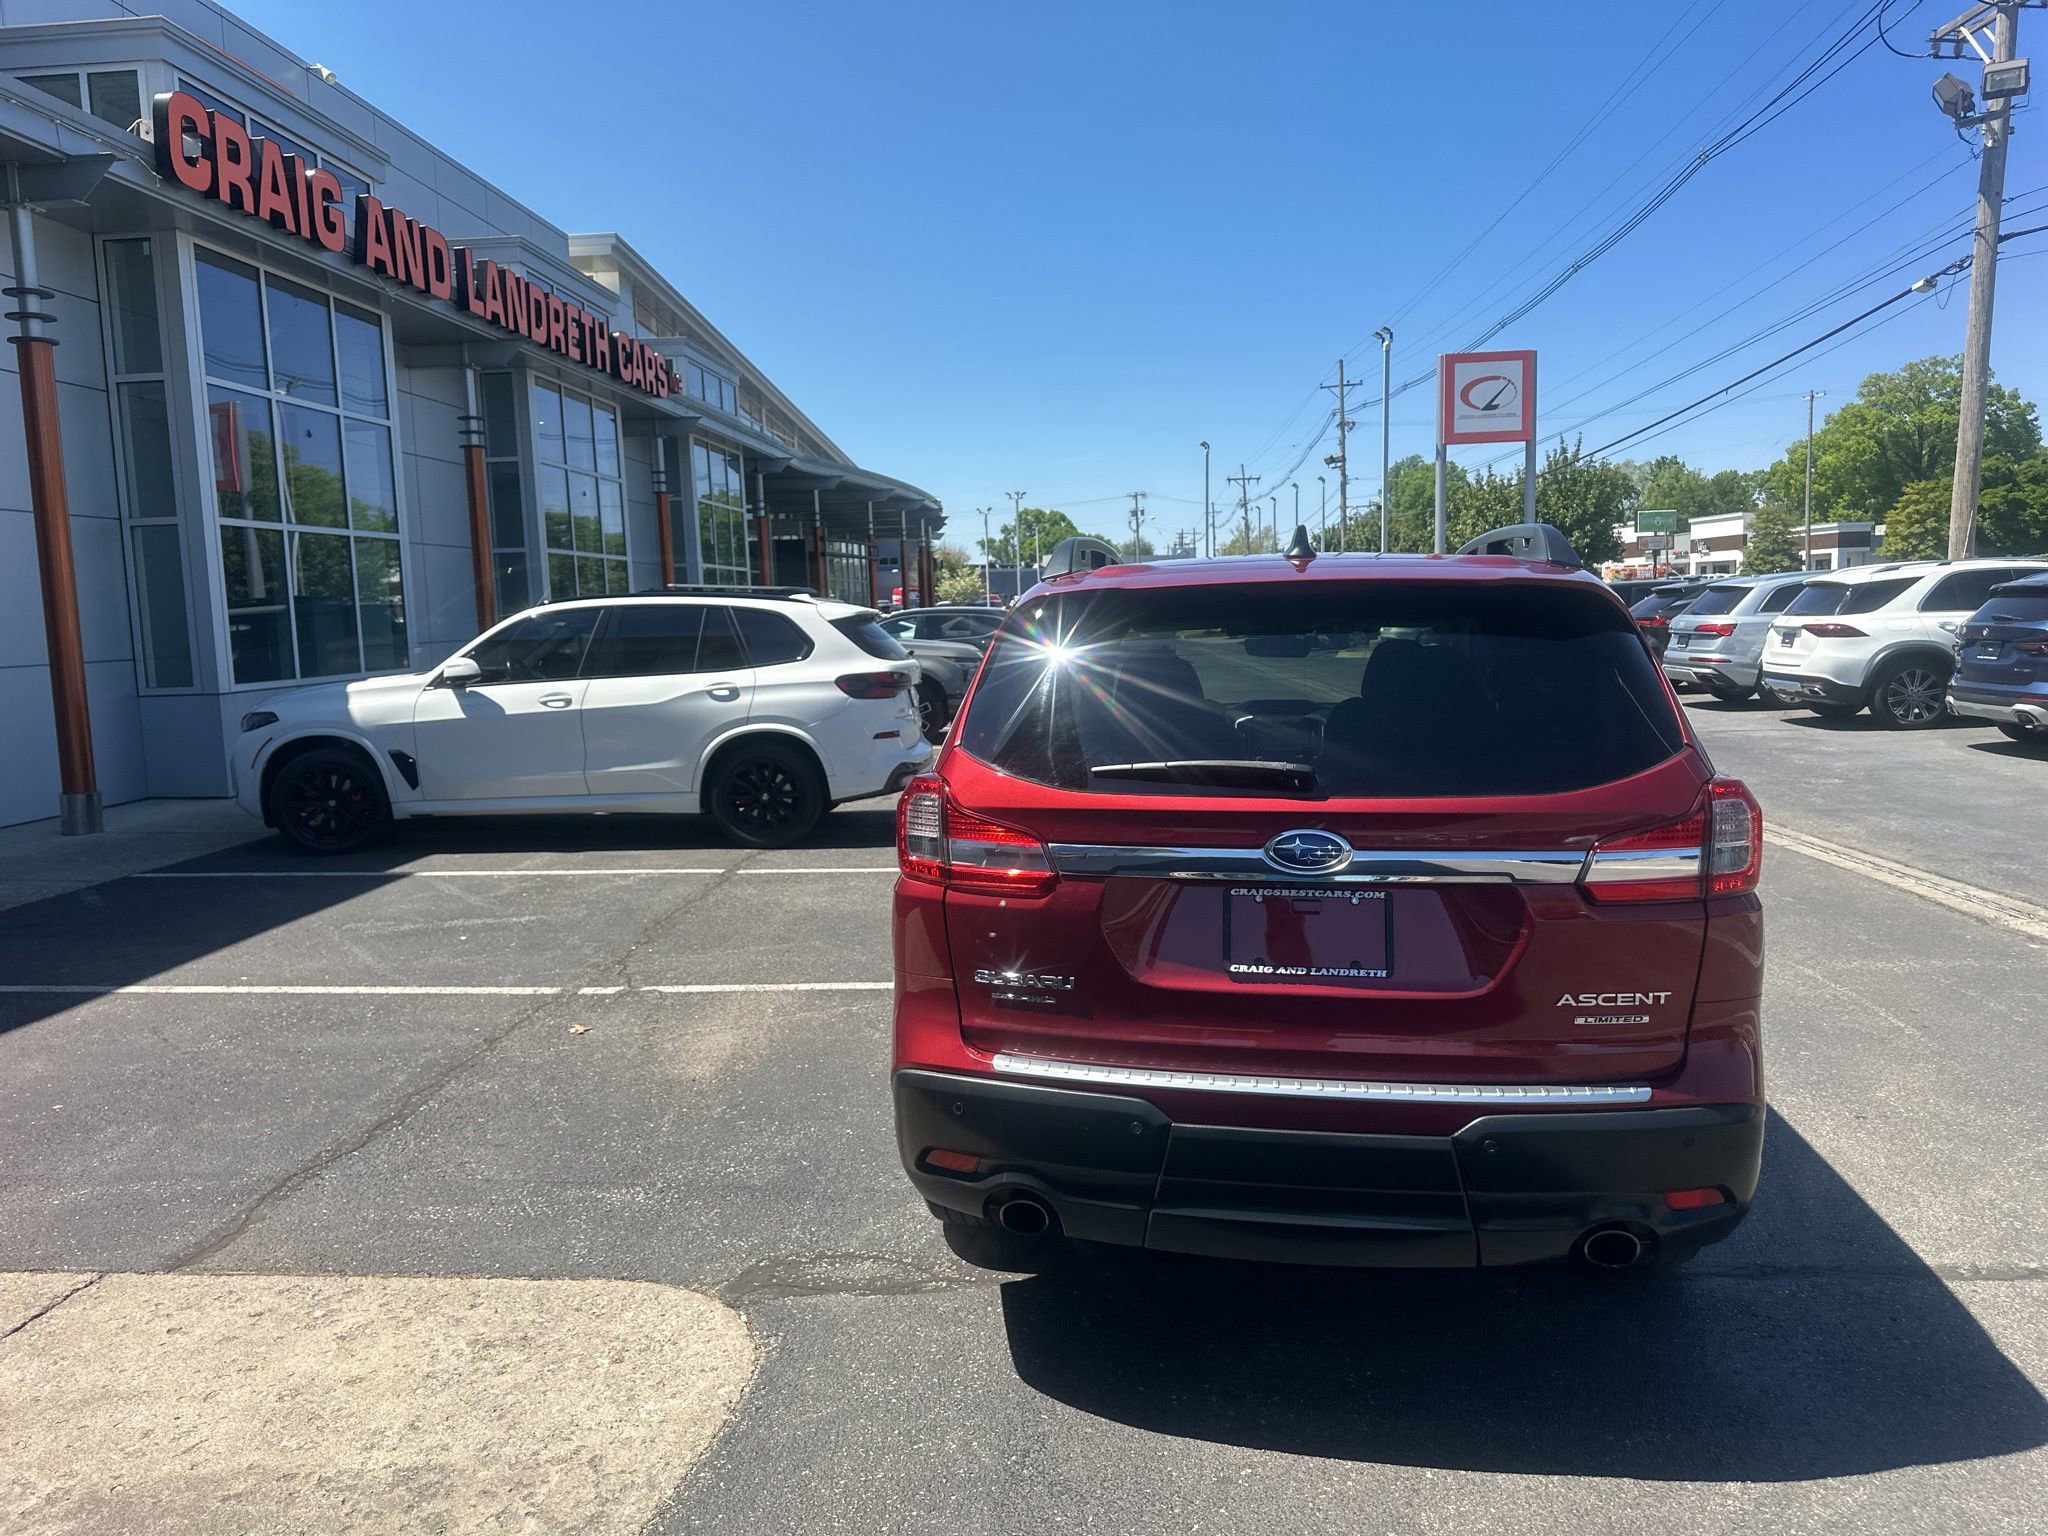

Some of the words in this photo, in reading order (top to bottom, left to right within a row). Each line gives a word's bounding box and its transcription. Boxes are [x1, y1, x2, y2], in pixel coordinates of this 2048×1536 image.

[167, 90, 346, 253] CRAIG
[365, 194, 451, 300] AND
[464, 246, 610, 375] LANDRETH
[617, 330, 669, 399] CARS
[1230, 888, 1385, 899] CRAIGSBESTCARS.COM
[1229, 964, 1273, 974] CRAIG
[1276, 966, 1307, 975] AND
[1310, 967, 1387, 978] LANDRETH
[974, 969, 1075, 990] SUBARU
[1556, 992, 1671, 1007] ASCENT
[1584, 1015, 1644, 1024] LIMITED
